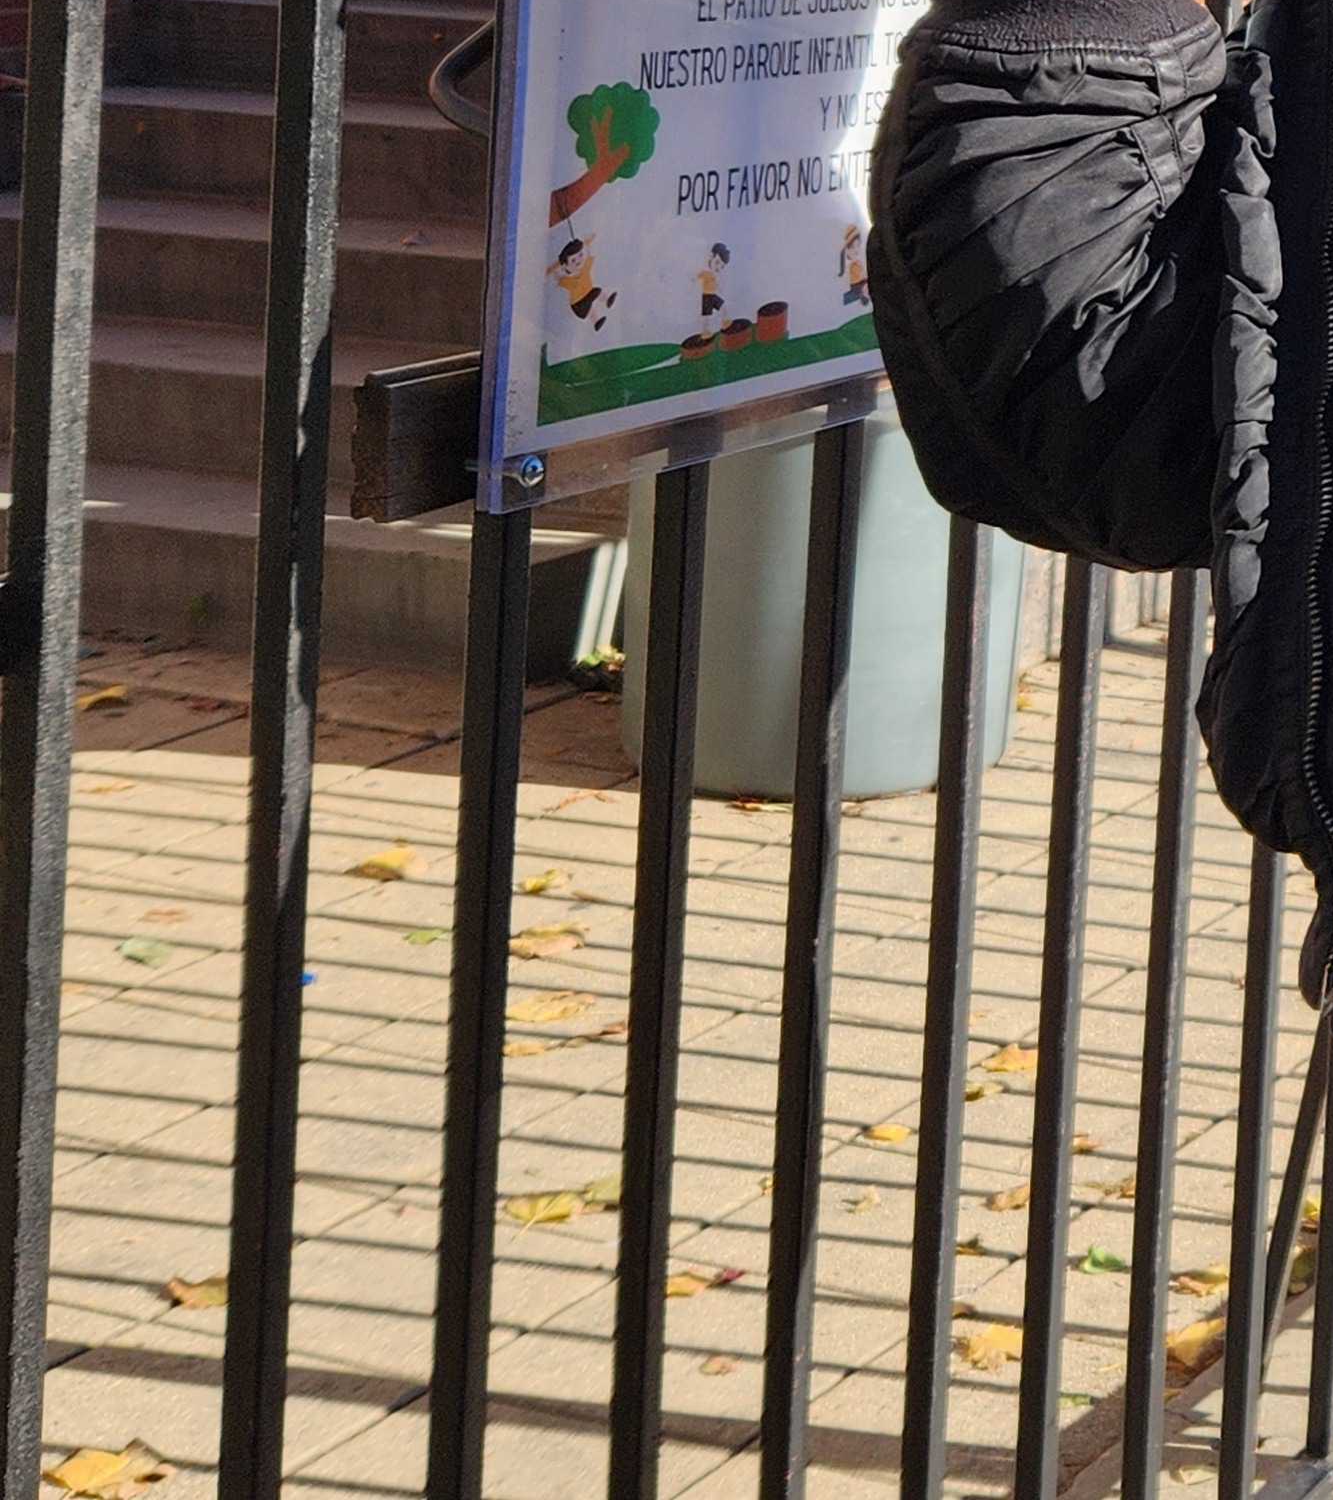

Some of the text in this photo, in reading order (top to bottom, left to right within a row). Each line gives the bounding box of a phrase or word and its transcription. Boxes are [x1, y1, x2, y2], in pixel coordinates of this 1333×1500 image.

[640, 46, 727, 91] NUESTRO
[732, 39, 803, 82] PARQUE
[807, 33, 878, 75] INFANTIL
[820, 95, 832, 131] Y
[837, 92, 857, 129] NO
[677, 169, 719, 215] POR
[726, 161, 790, 209] FAVOR
[797, 156, 823, 198] NO
